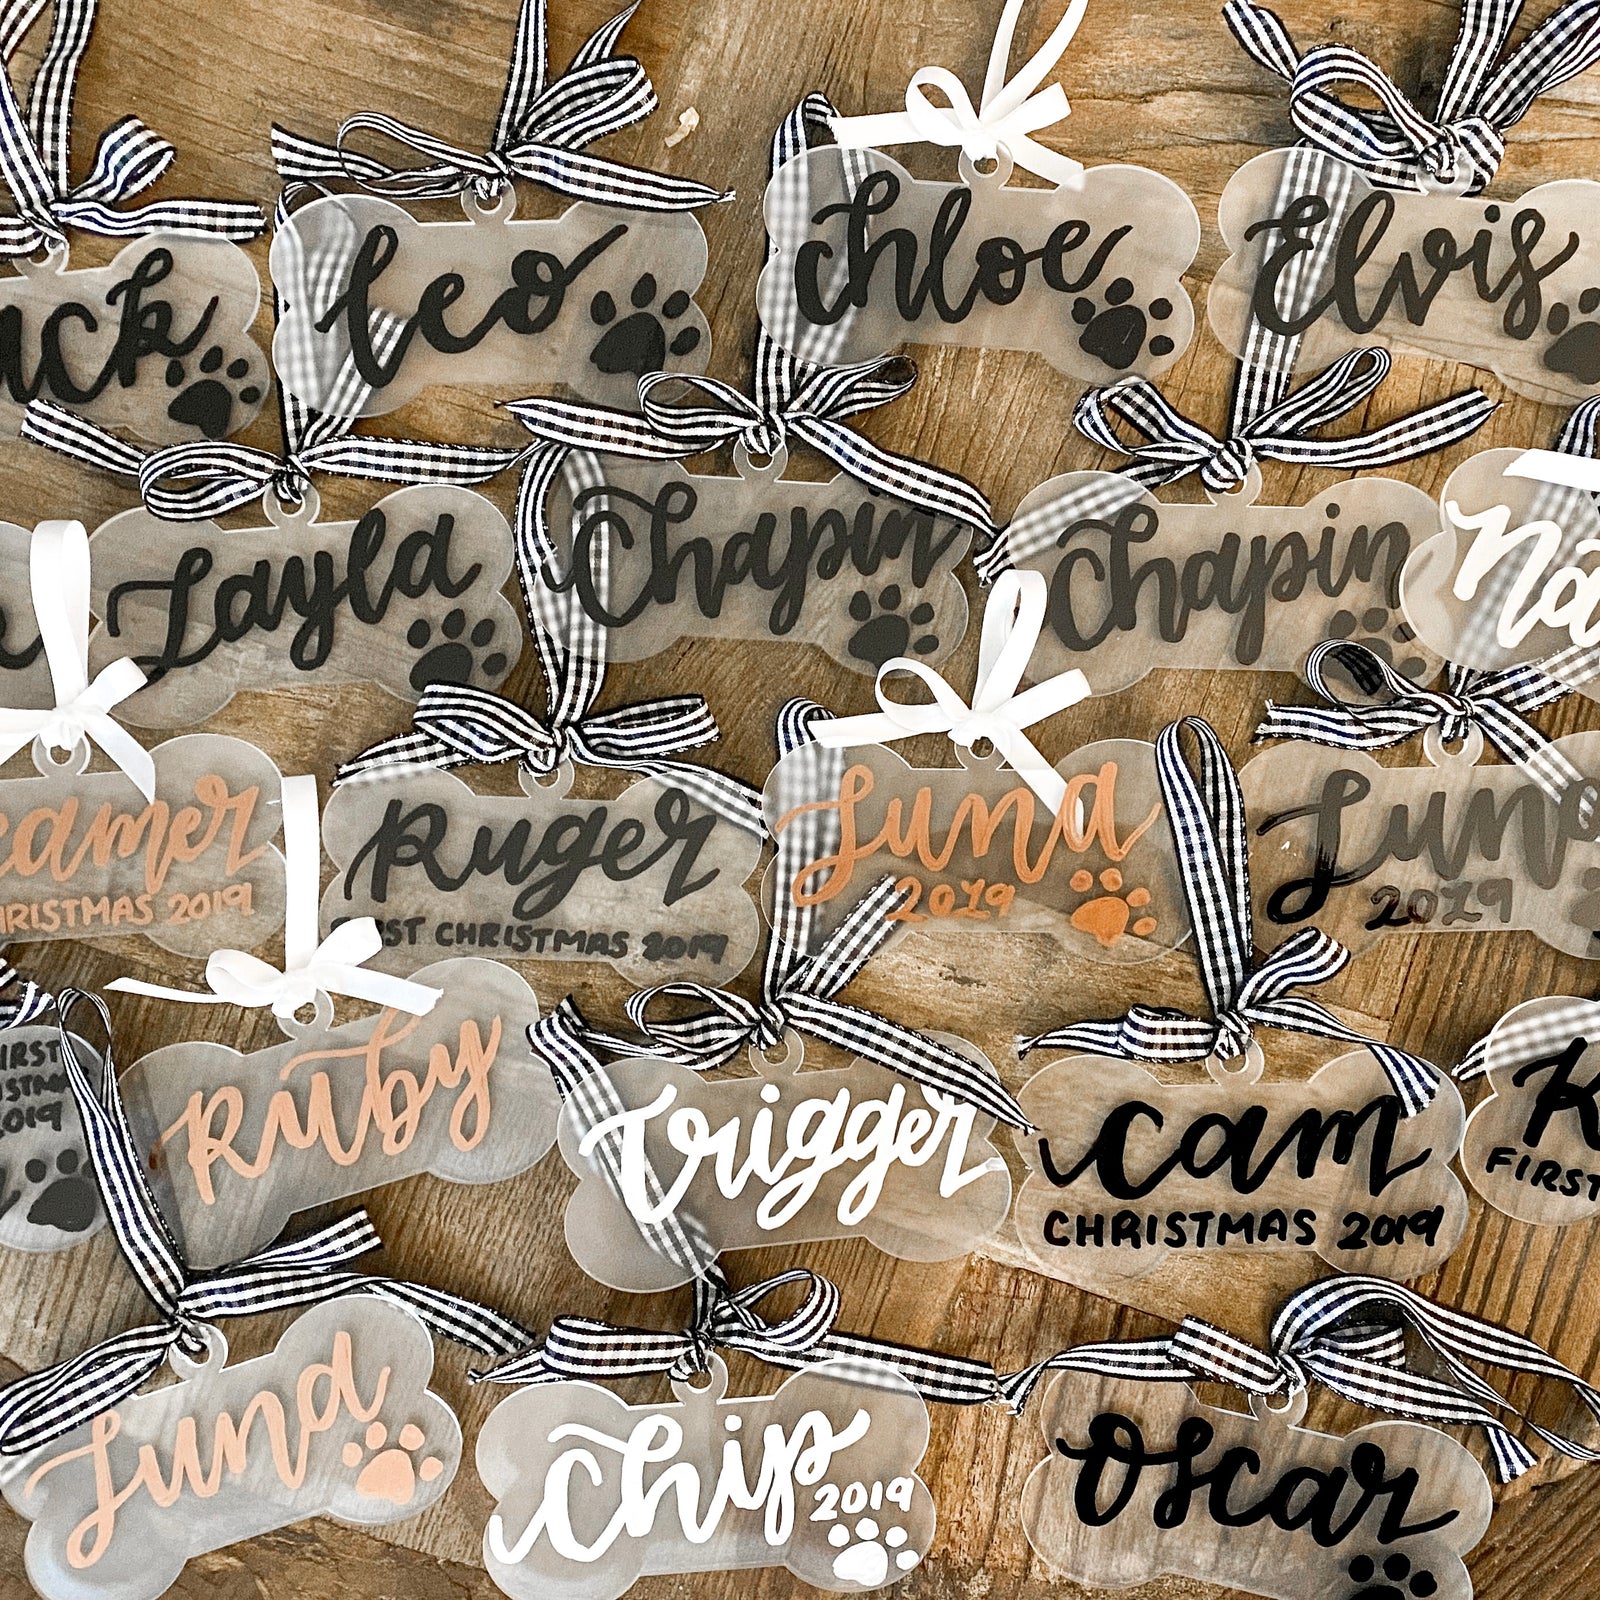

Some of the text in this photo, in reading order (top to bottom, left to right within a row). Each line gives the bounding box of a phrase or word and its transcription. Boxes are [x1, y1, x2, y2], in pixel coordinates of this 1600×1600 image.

[1245, 190, 1580, 340] Elvis
[107, 507, 482, 688] Layla
[542, 481, 962, 635] Chapin
[1048, 502, 1412, 665] Chapin
[0, 775, 268, 894] amer
[344, 789, 720, 922] Ruger
[776, 761, 1162, 907] Luna
[887, 878, 1016, 923] 2019
[167, 882, 254, 926] 2019
[435, 922, 630, 959] CHRISTMAS
[642, 931, 729, 964] 2019
[1366, 877, 1514, 931] 2019
[0, 1101, 62, 1136] 019
[150, 1006, 501, 1204] Ruby
[579, 1083, 1007, 1231] Trigger
[1043, 1205, 1444, 1250] CHRISTMAS 2019
[24, 1331, 390, 1569] Luna
[809, 1477, 915, 1521] 2019
[1055, 1412, 1460, 1548] Oscar
